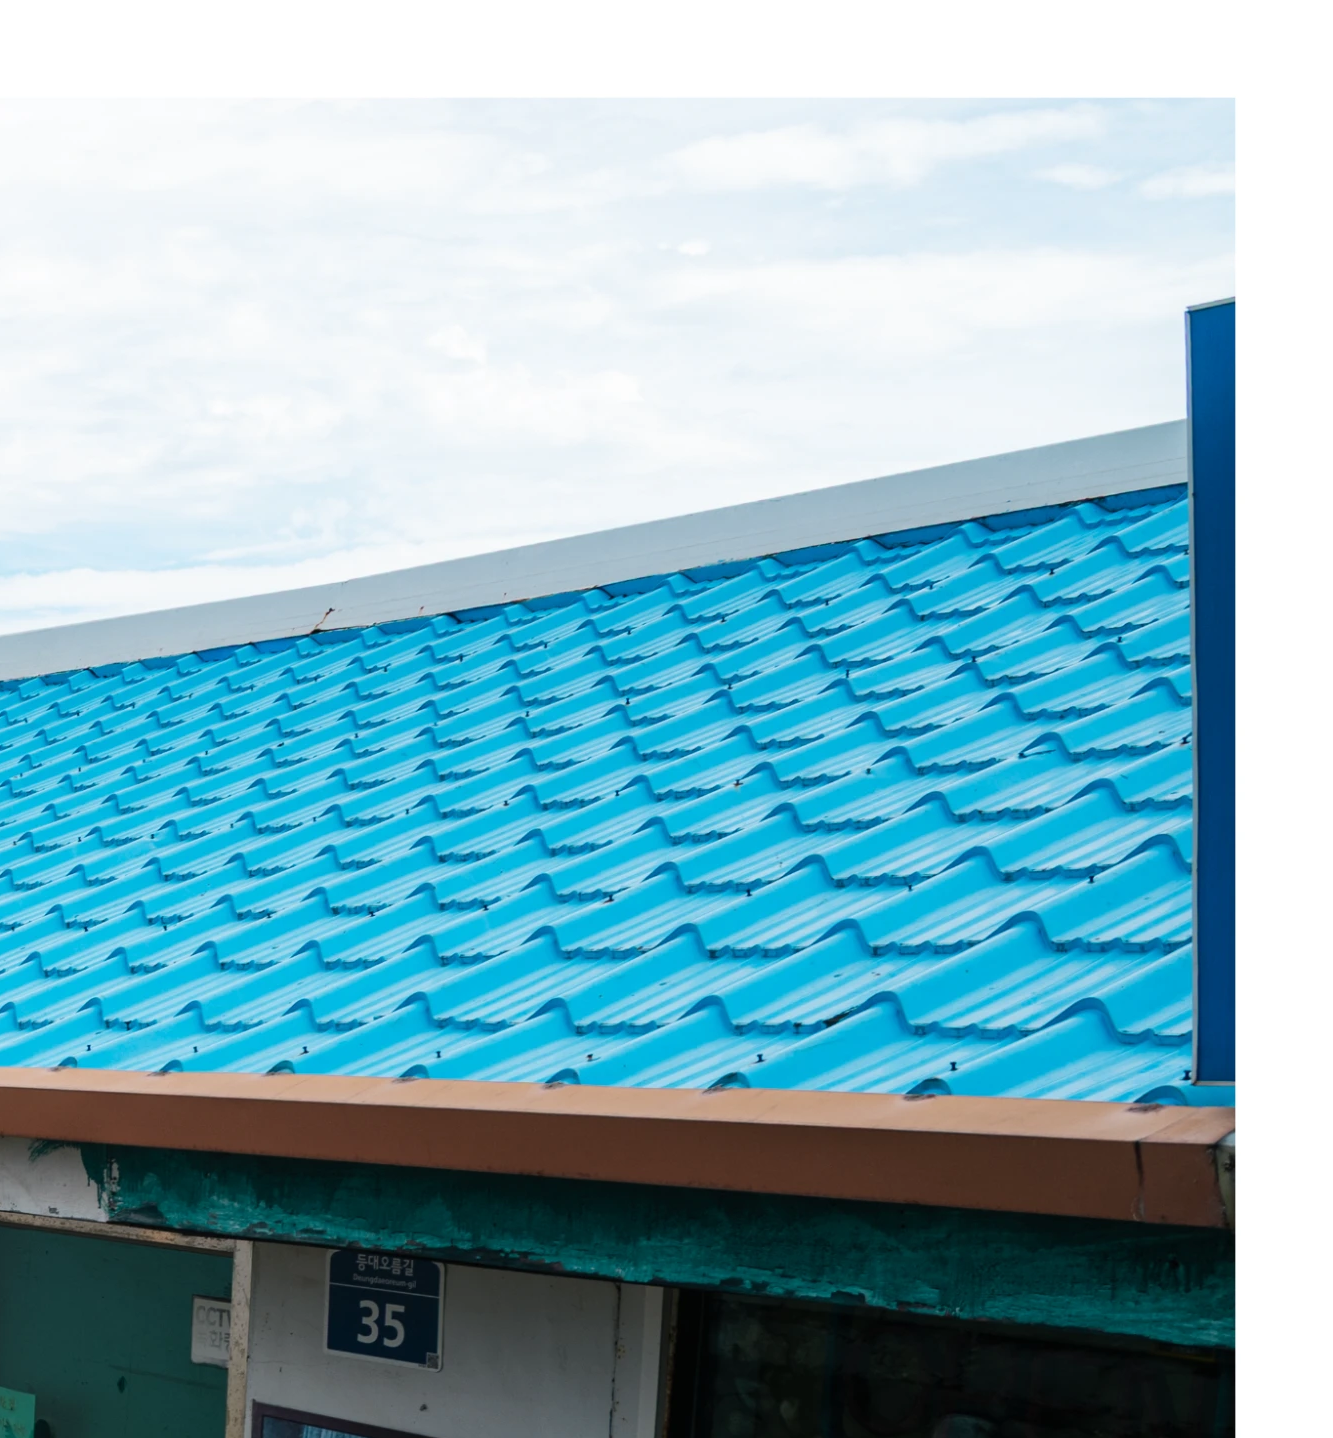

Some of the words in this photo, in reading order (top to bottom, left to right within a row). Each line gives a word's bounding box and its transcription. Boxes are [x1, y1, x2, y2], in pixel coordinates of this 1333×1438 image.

[356, 1254, 414, 1276] 등대오름길
[353, 1273, 417, 1289] Deungdaeoreum-gil
[357, 1299, 405, 1348] 35
